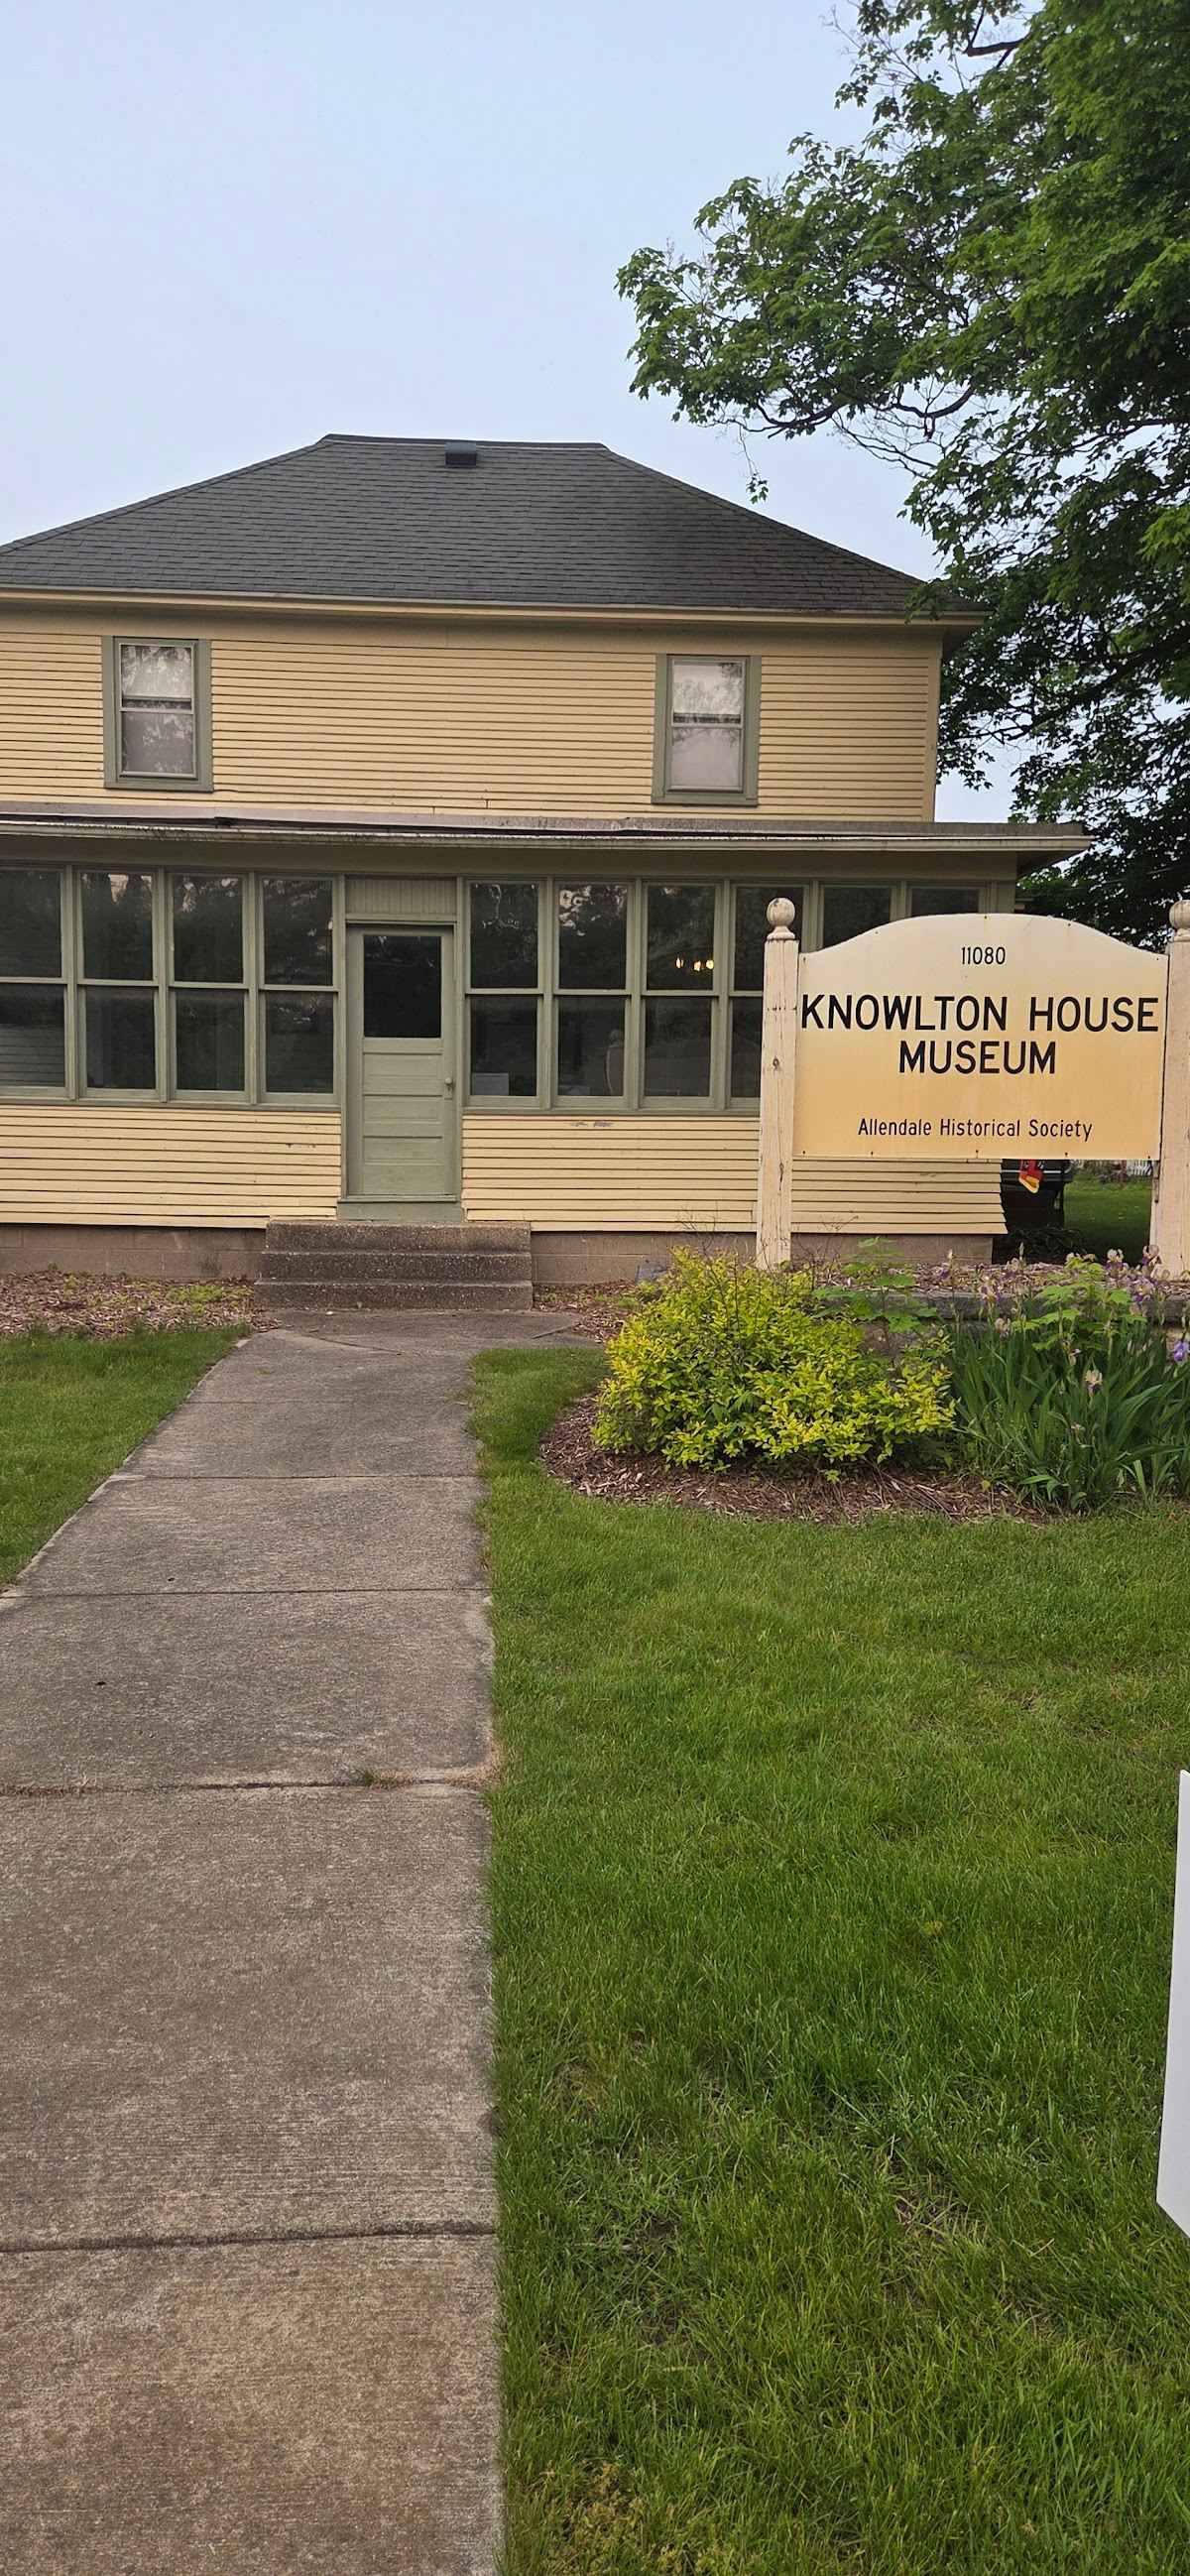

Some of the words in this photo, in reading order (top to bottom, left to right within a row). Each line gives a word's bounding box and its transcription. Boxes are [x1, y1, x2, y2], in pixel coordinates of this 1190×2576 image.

[961, 946, 1006, 965] 11080
[801, 994, 1007, 1031] KNOWLTON
[1029, 996, 1158, 1033] HOUSE
[898, 1040, 1056, 1074] MUSEUM
[858, 1118, 931, 1137] Allendale
[940, 1118, 1020, 1138] Historical
[1028, 1119, 1093, 1142] Society
